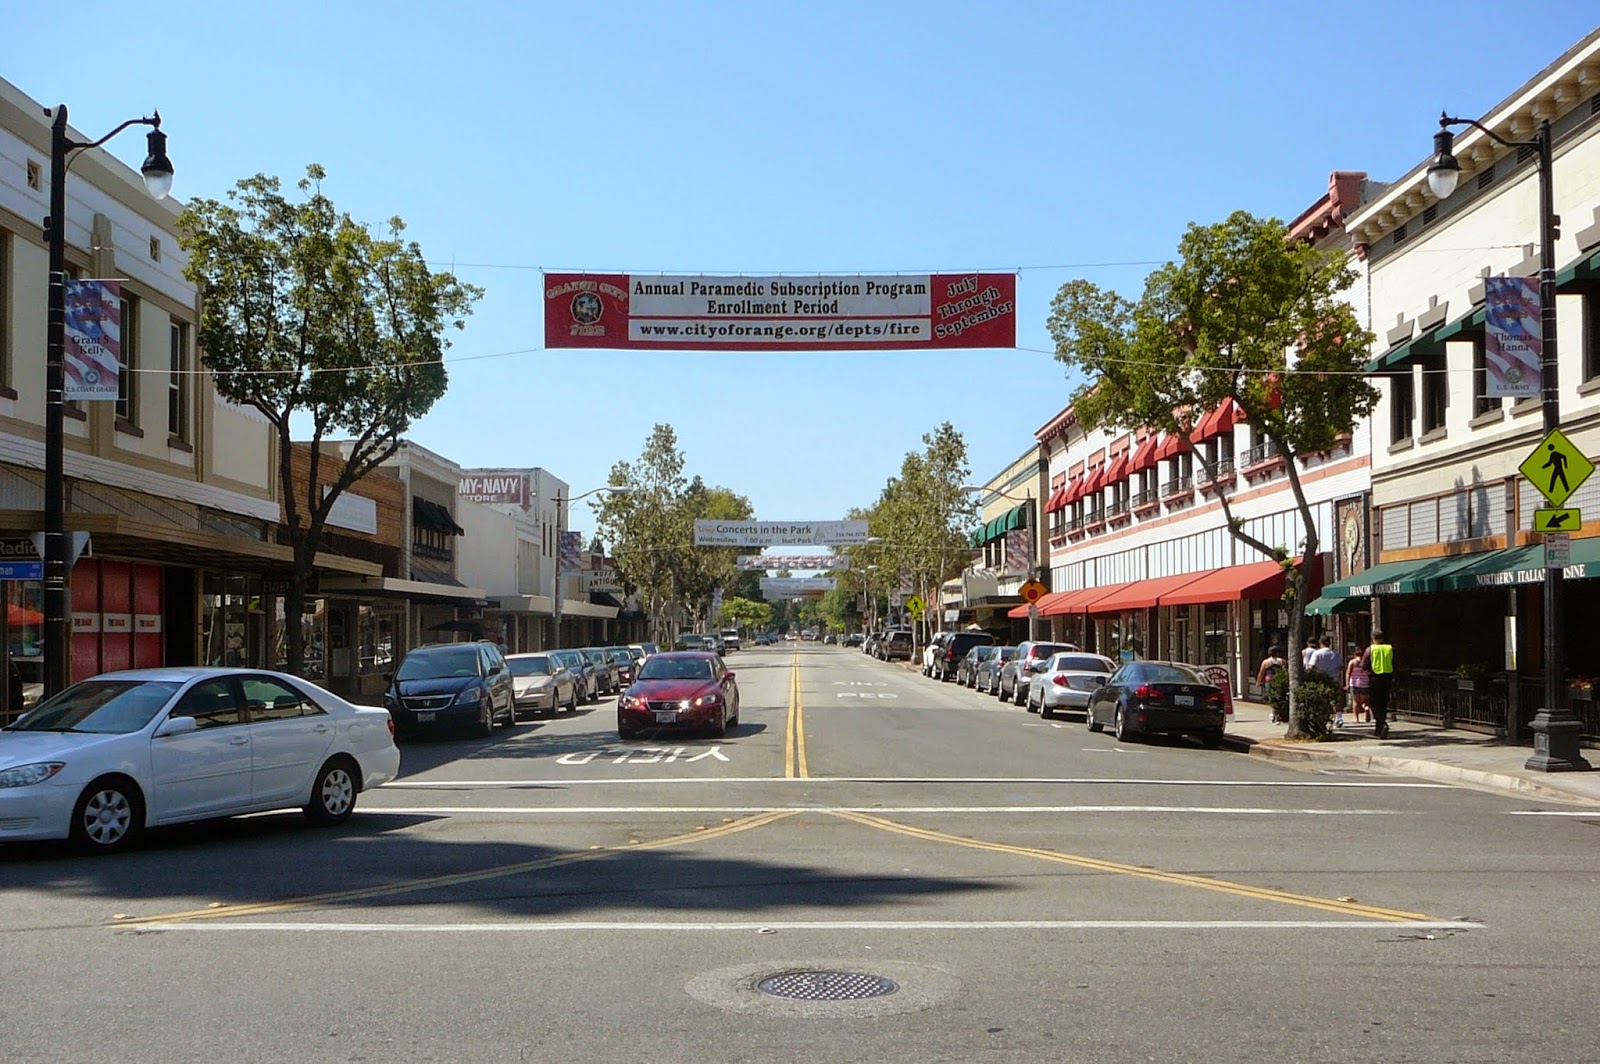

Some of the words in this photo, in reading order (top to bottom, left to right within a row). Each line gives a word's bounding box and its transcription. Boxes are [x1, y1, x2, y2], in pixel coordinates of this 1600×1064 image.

[634, 281, 684, 295] Annual
[690, 281, 764, 296] Paramedic
[770, 281, 860, 299] Subscription
[866, 281, 926, 299] Program
[947, 277, 978, 296] July
[707, 300, 788, 314] Enrollment
[794, 300, 838, 314] Period
[937, 286, 1000, 319] Through
[935, 301, 1012, 339] September
[640, 323, 920, 340] www.cityoforange.org/depts/fire
[1493, 332, 1532, 341] Thomas
[71, 335, 100, 344] Grant
[1497, 343, 1529, 351] Hanna
[80, 345, 105, 356] Kelly
[716, 524, 758, 534] Concerts
[760, 525, 769, 534] in
[772, 525, 788, 534] the
[790, 525, 812, 534] Park
[1476, 571, 1514, 586] NORTHERN
[1563, 564, 1585, 579] ISINE
